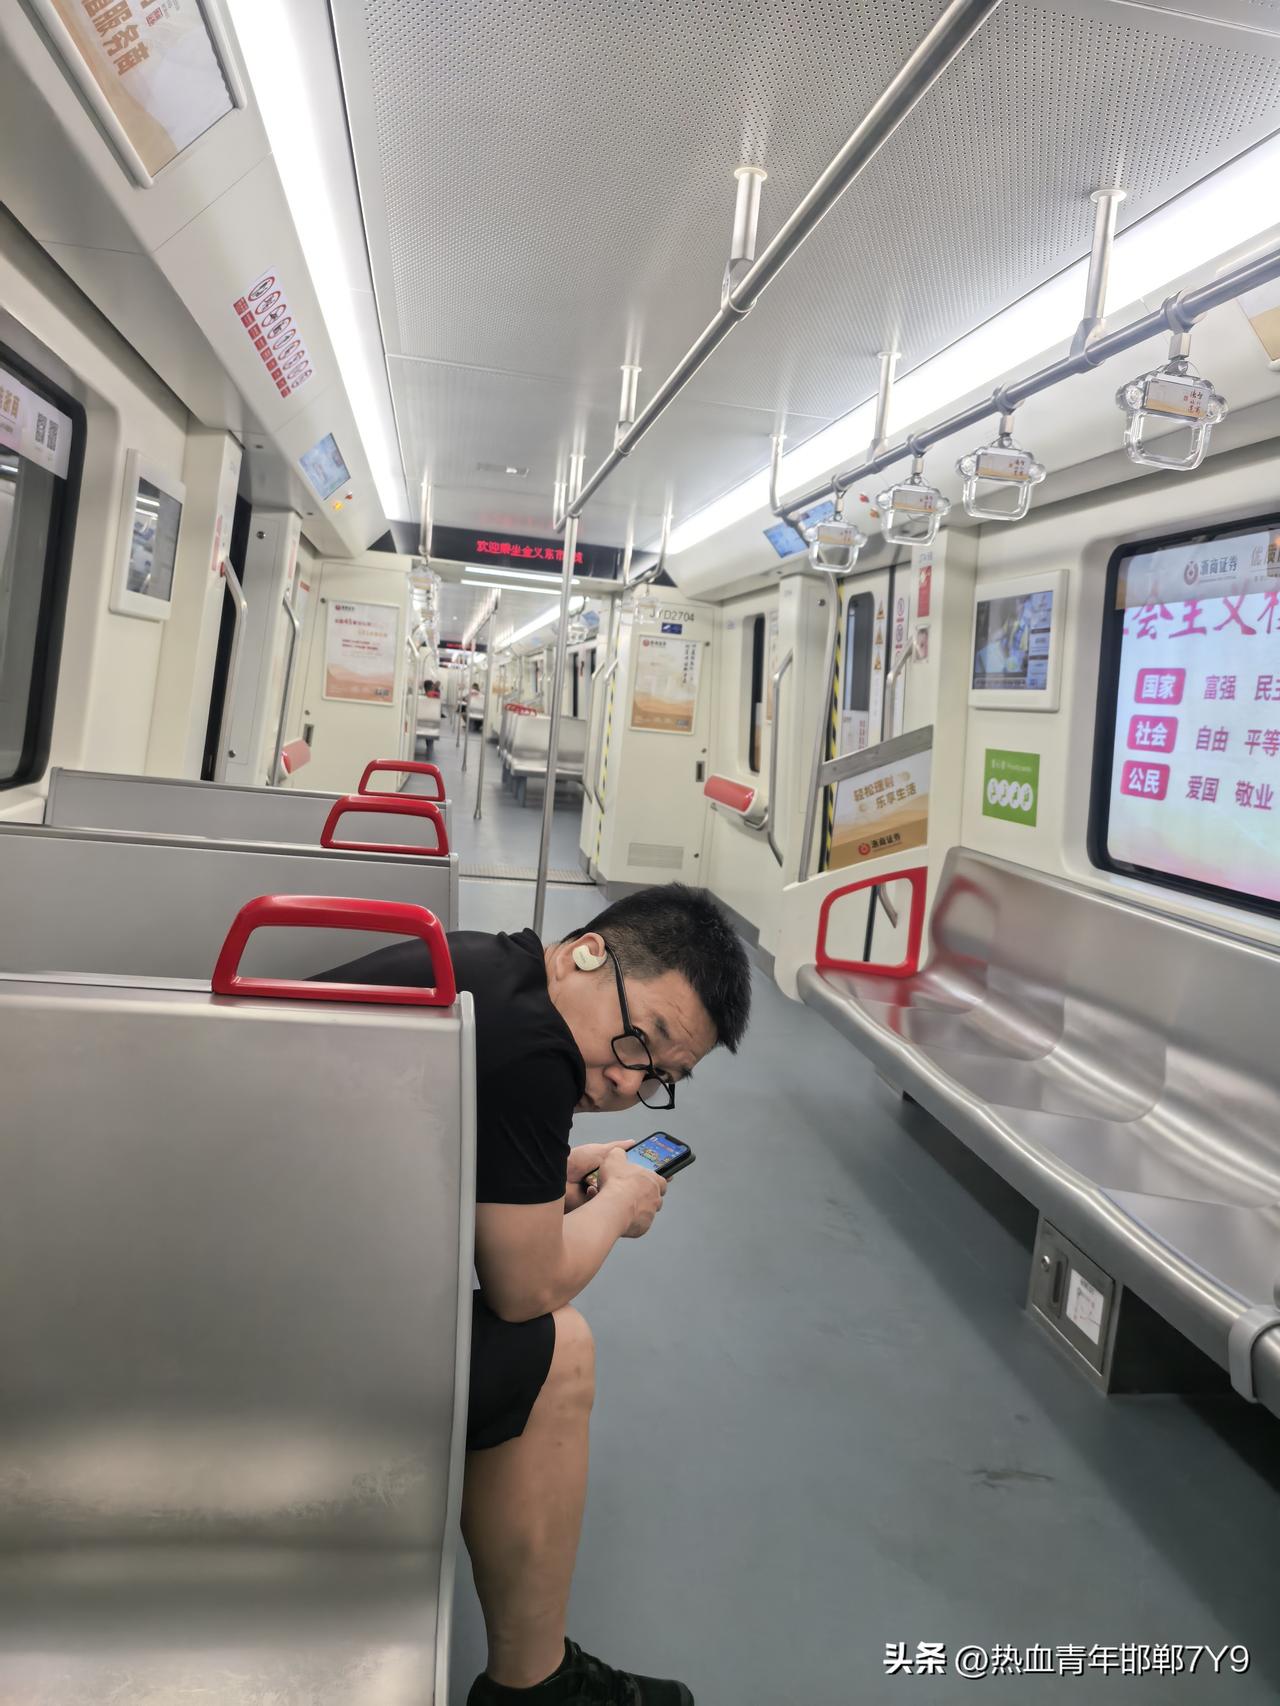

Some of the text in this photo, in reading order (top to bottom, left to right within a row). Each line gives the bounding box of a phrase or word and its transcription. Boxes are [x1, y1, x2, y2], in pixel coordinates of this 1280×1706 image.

[1123, 580, 1280, 639] 会主义
[1141, 674, 1177, 699] 国家
[1203, 674, 1237, 700] 富强
[1135, 721, 1169, 747] 社会
[1196, 725, 1280, 757] 自由 平等
[1128, 767, 1161, 794] 公民
[1186, 775, 1274, 810] 爱国 敬业
[876, 782, 917, 809] 乐享生活
